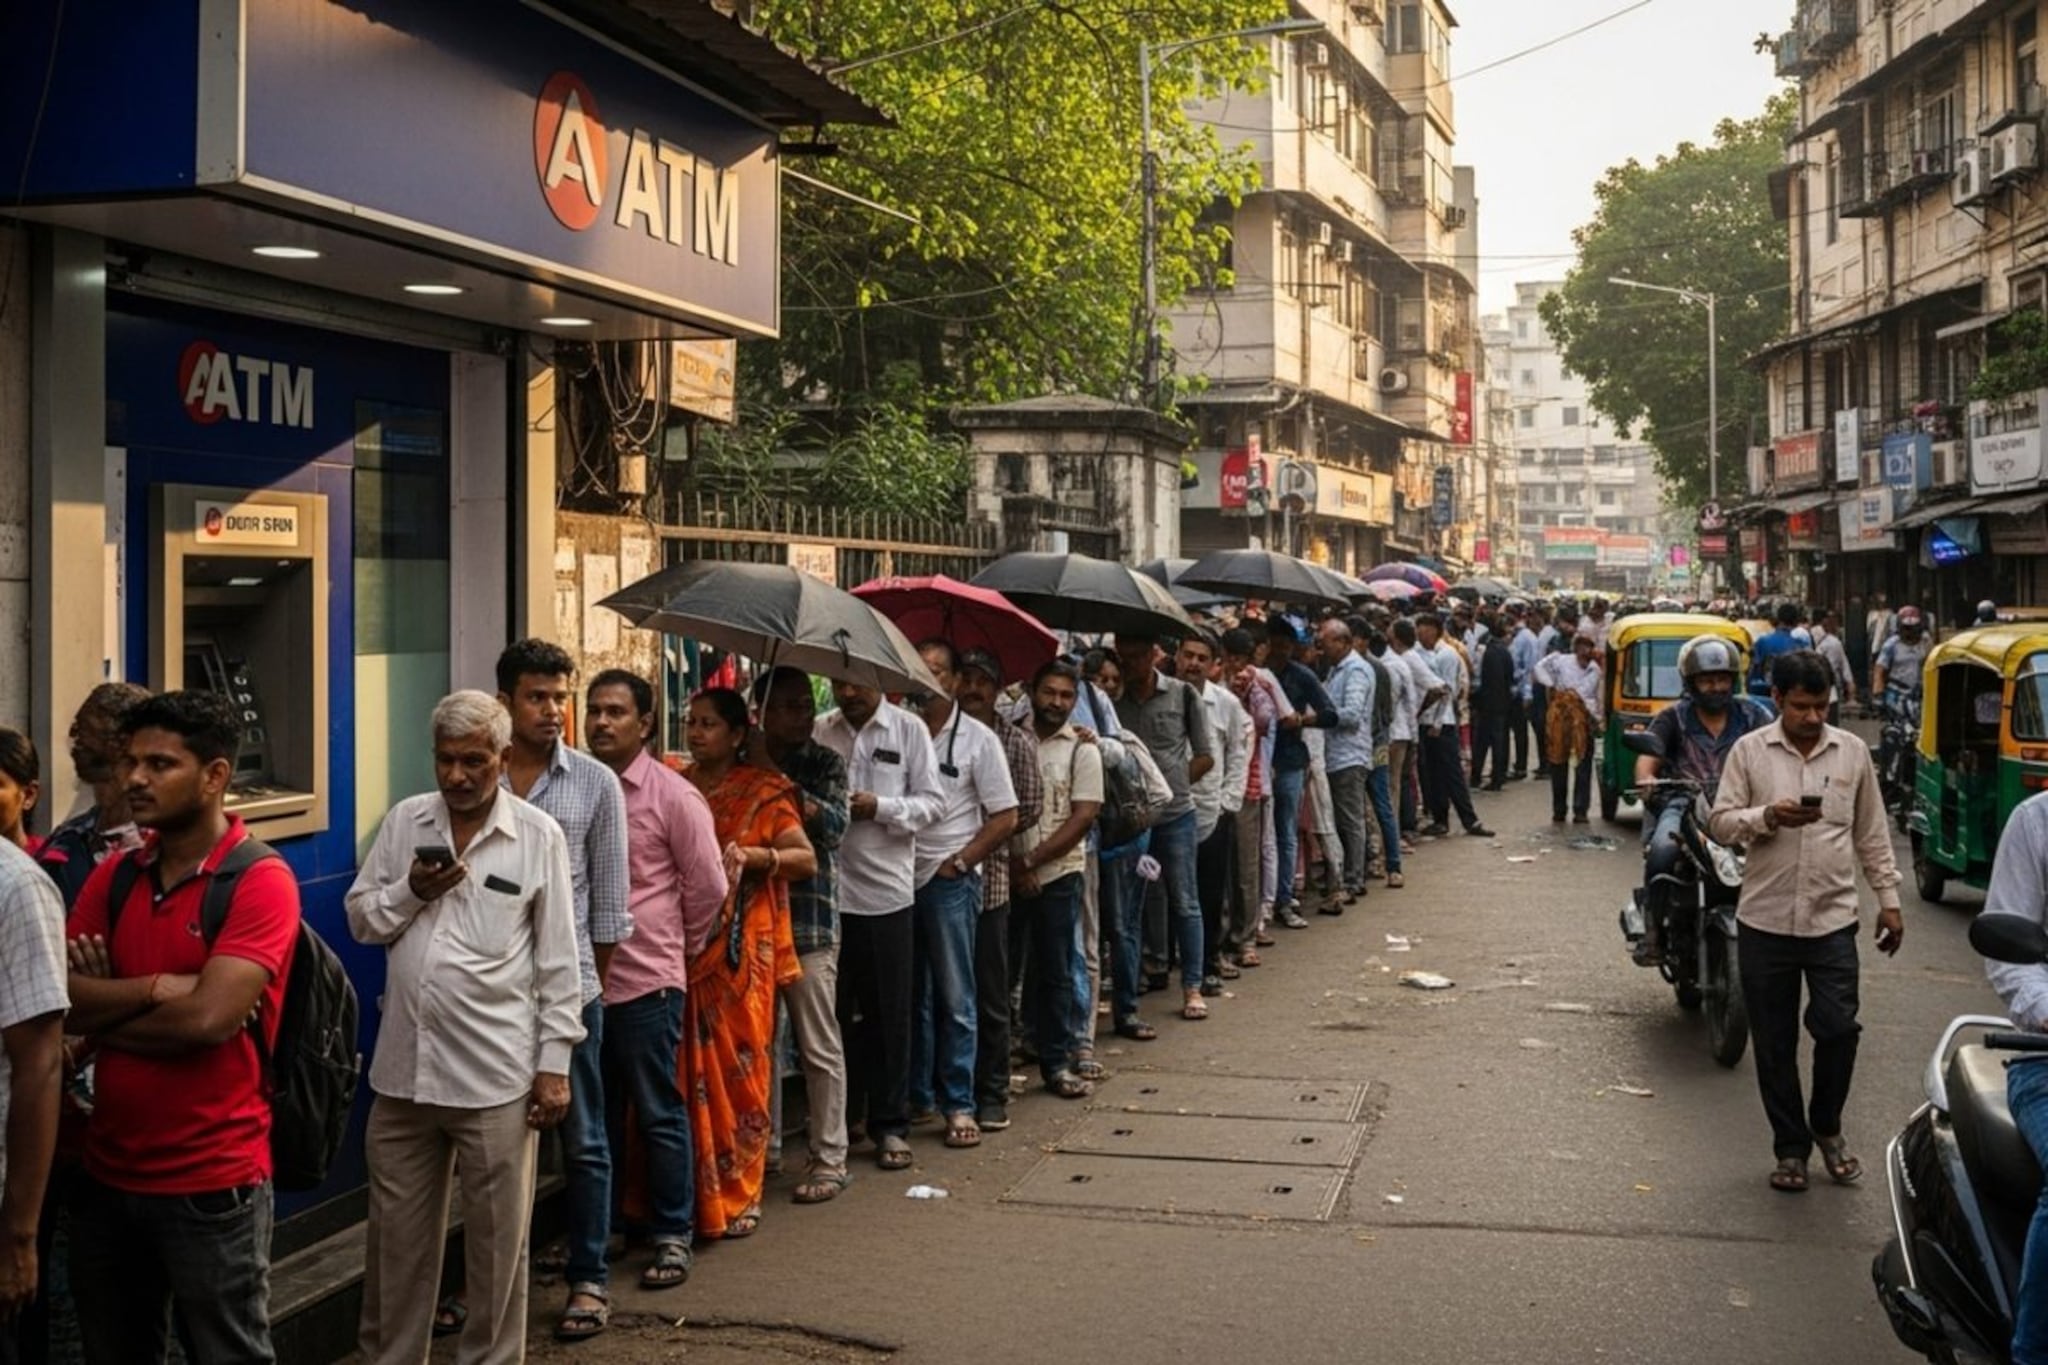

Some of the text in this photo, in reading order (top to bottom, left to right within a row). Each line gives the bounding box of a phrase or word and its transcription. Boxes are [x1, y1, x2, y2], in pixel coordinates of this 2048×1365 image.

[545, 88, 739, 267] A ATM
[202, 351, 314, 430] ATM
